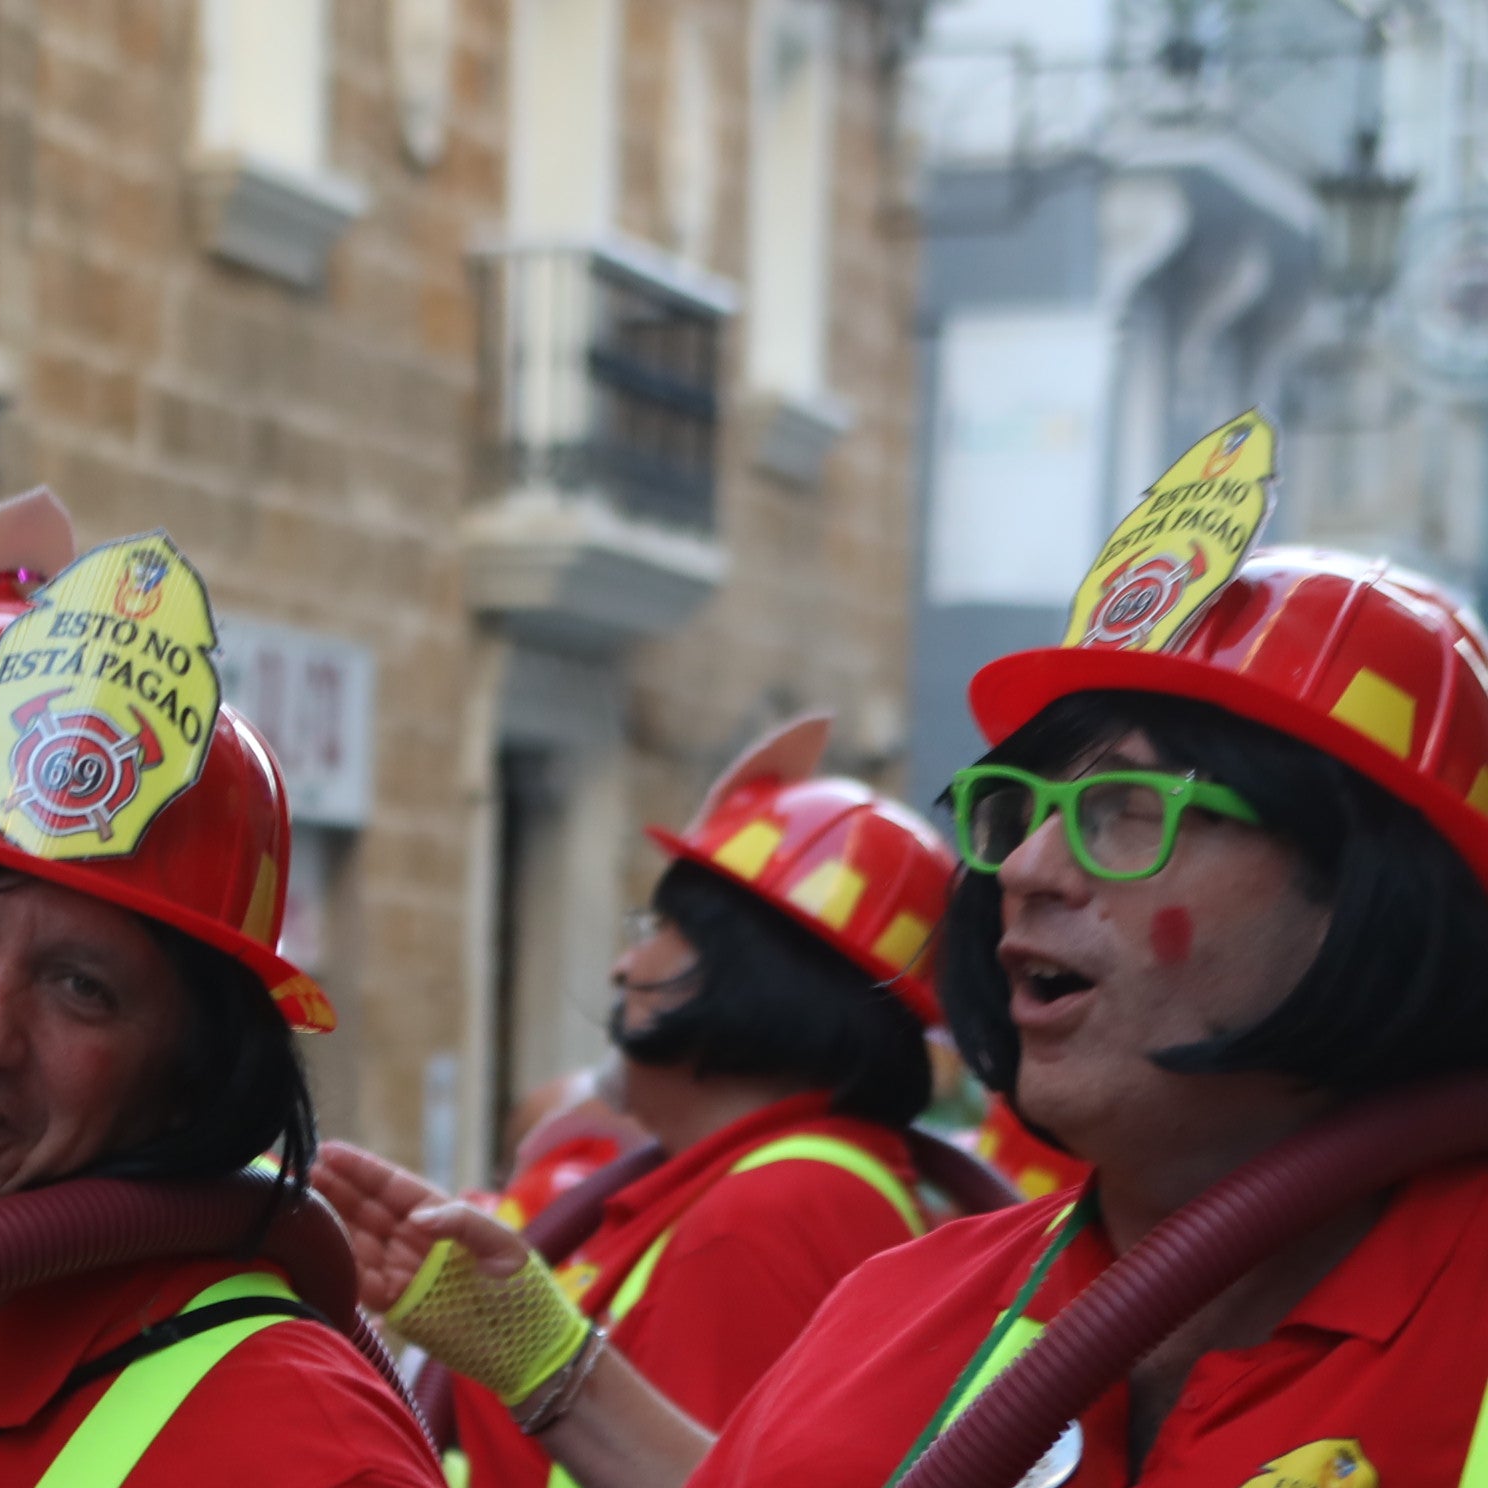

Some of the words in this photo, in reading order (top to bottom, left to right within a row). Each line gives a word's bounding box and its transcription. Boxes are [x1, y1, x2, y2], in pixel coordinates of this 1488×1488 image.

[1150, 480, 1214, 513] ESTO
[1213, 479, 1251, 504] NO
[1097, 508, 1176, 569] ESTÁ
[1170, 508, 1245, 554] PAGAO
[1107, 586, 1159, 623] 69
[48, 611, 138, 646] ESTO
[143, 632, 191, 677] NO
[91, 653, 202, 746] PAGAO
[40, 746, 111, 798] 69
